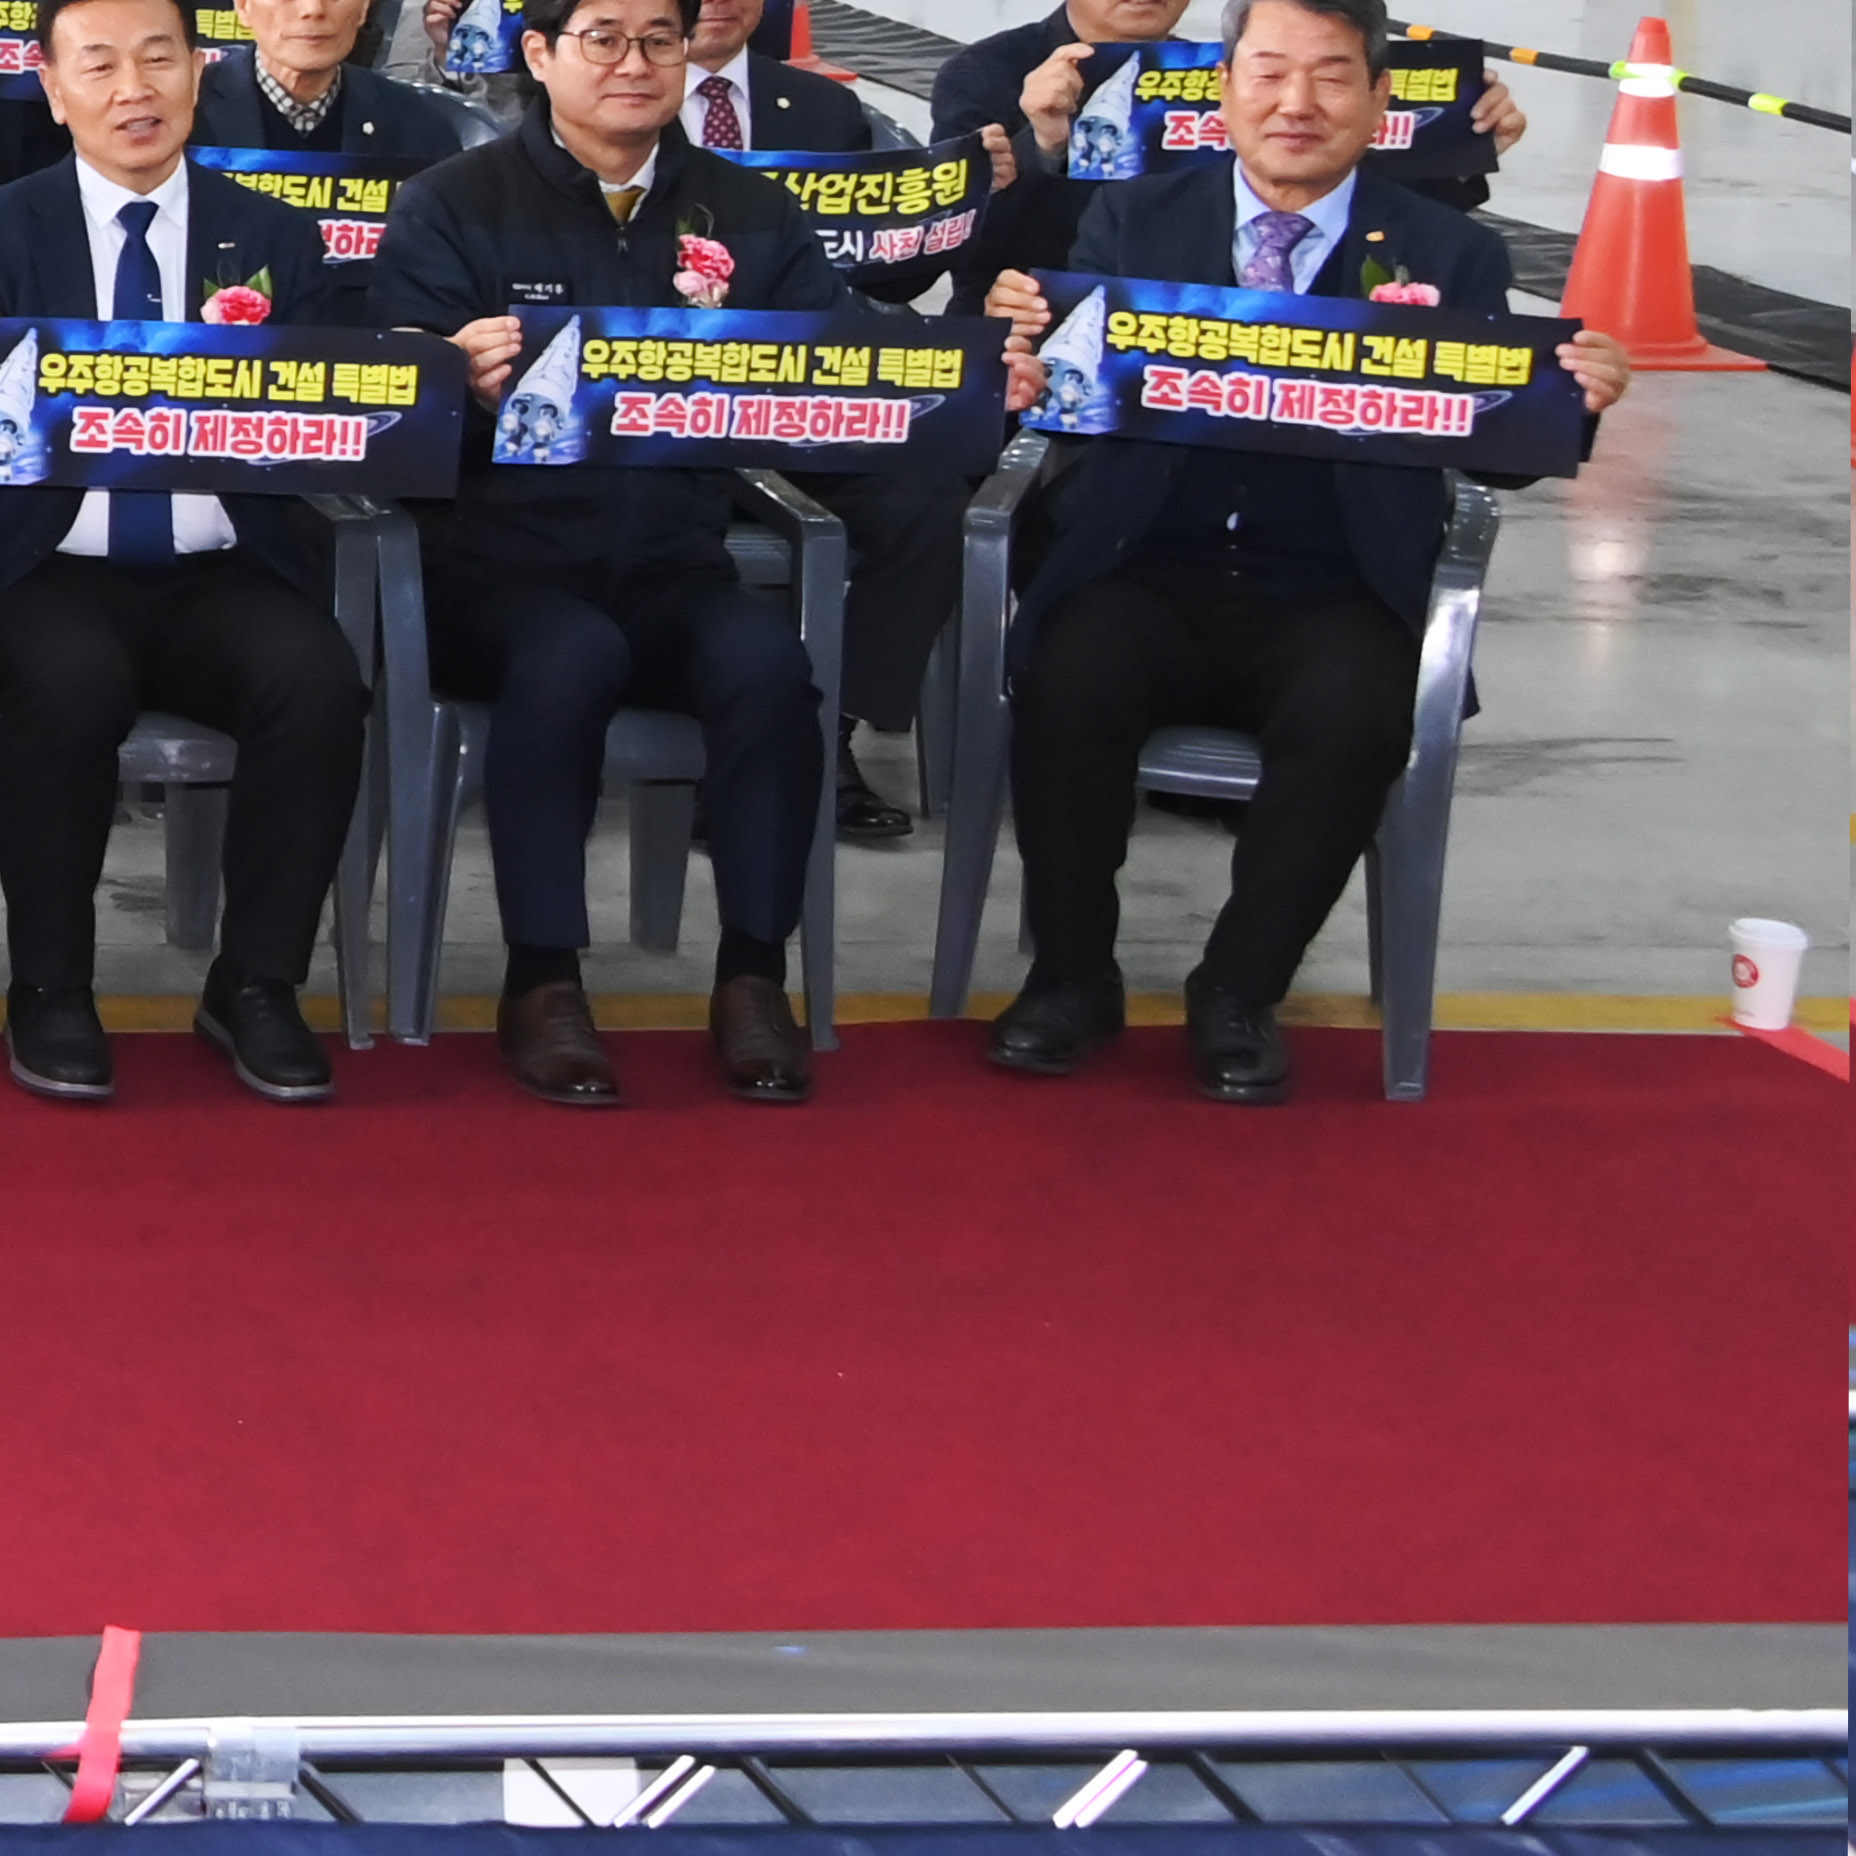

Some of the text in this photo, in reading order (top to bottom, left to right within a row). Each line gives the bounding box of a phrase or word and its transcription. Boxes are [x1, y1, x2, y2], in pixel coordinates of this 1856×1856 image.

[337, 178, 389, 213] 건설
[869, 209, 977, 263] 사천 설립!
[581, 339, 963, 389] 우주항공복합도시 건설 특별법
[1106, 311, 1532, 386] 우주항공복합도시 건설 특별법
[39, 353, 418, 406] 우주항공복합도시 건설 특별법
[1141, 364, 1475, 437] 조속히 제정하라!!
[70, 406, 367, 461] 조속히 제정하라!!
[610, 391, 912, 443] 조속히 제정하라!!
